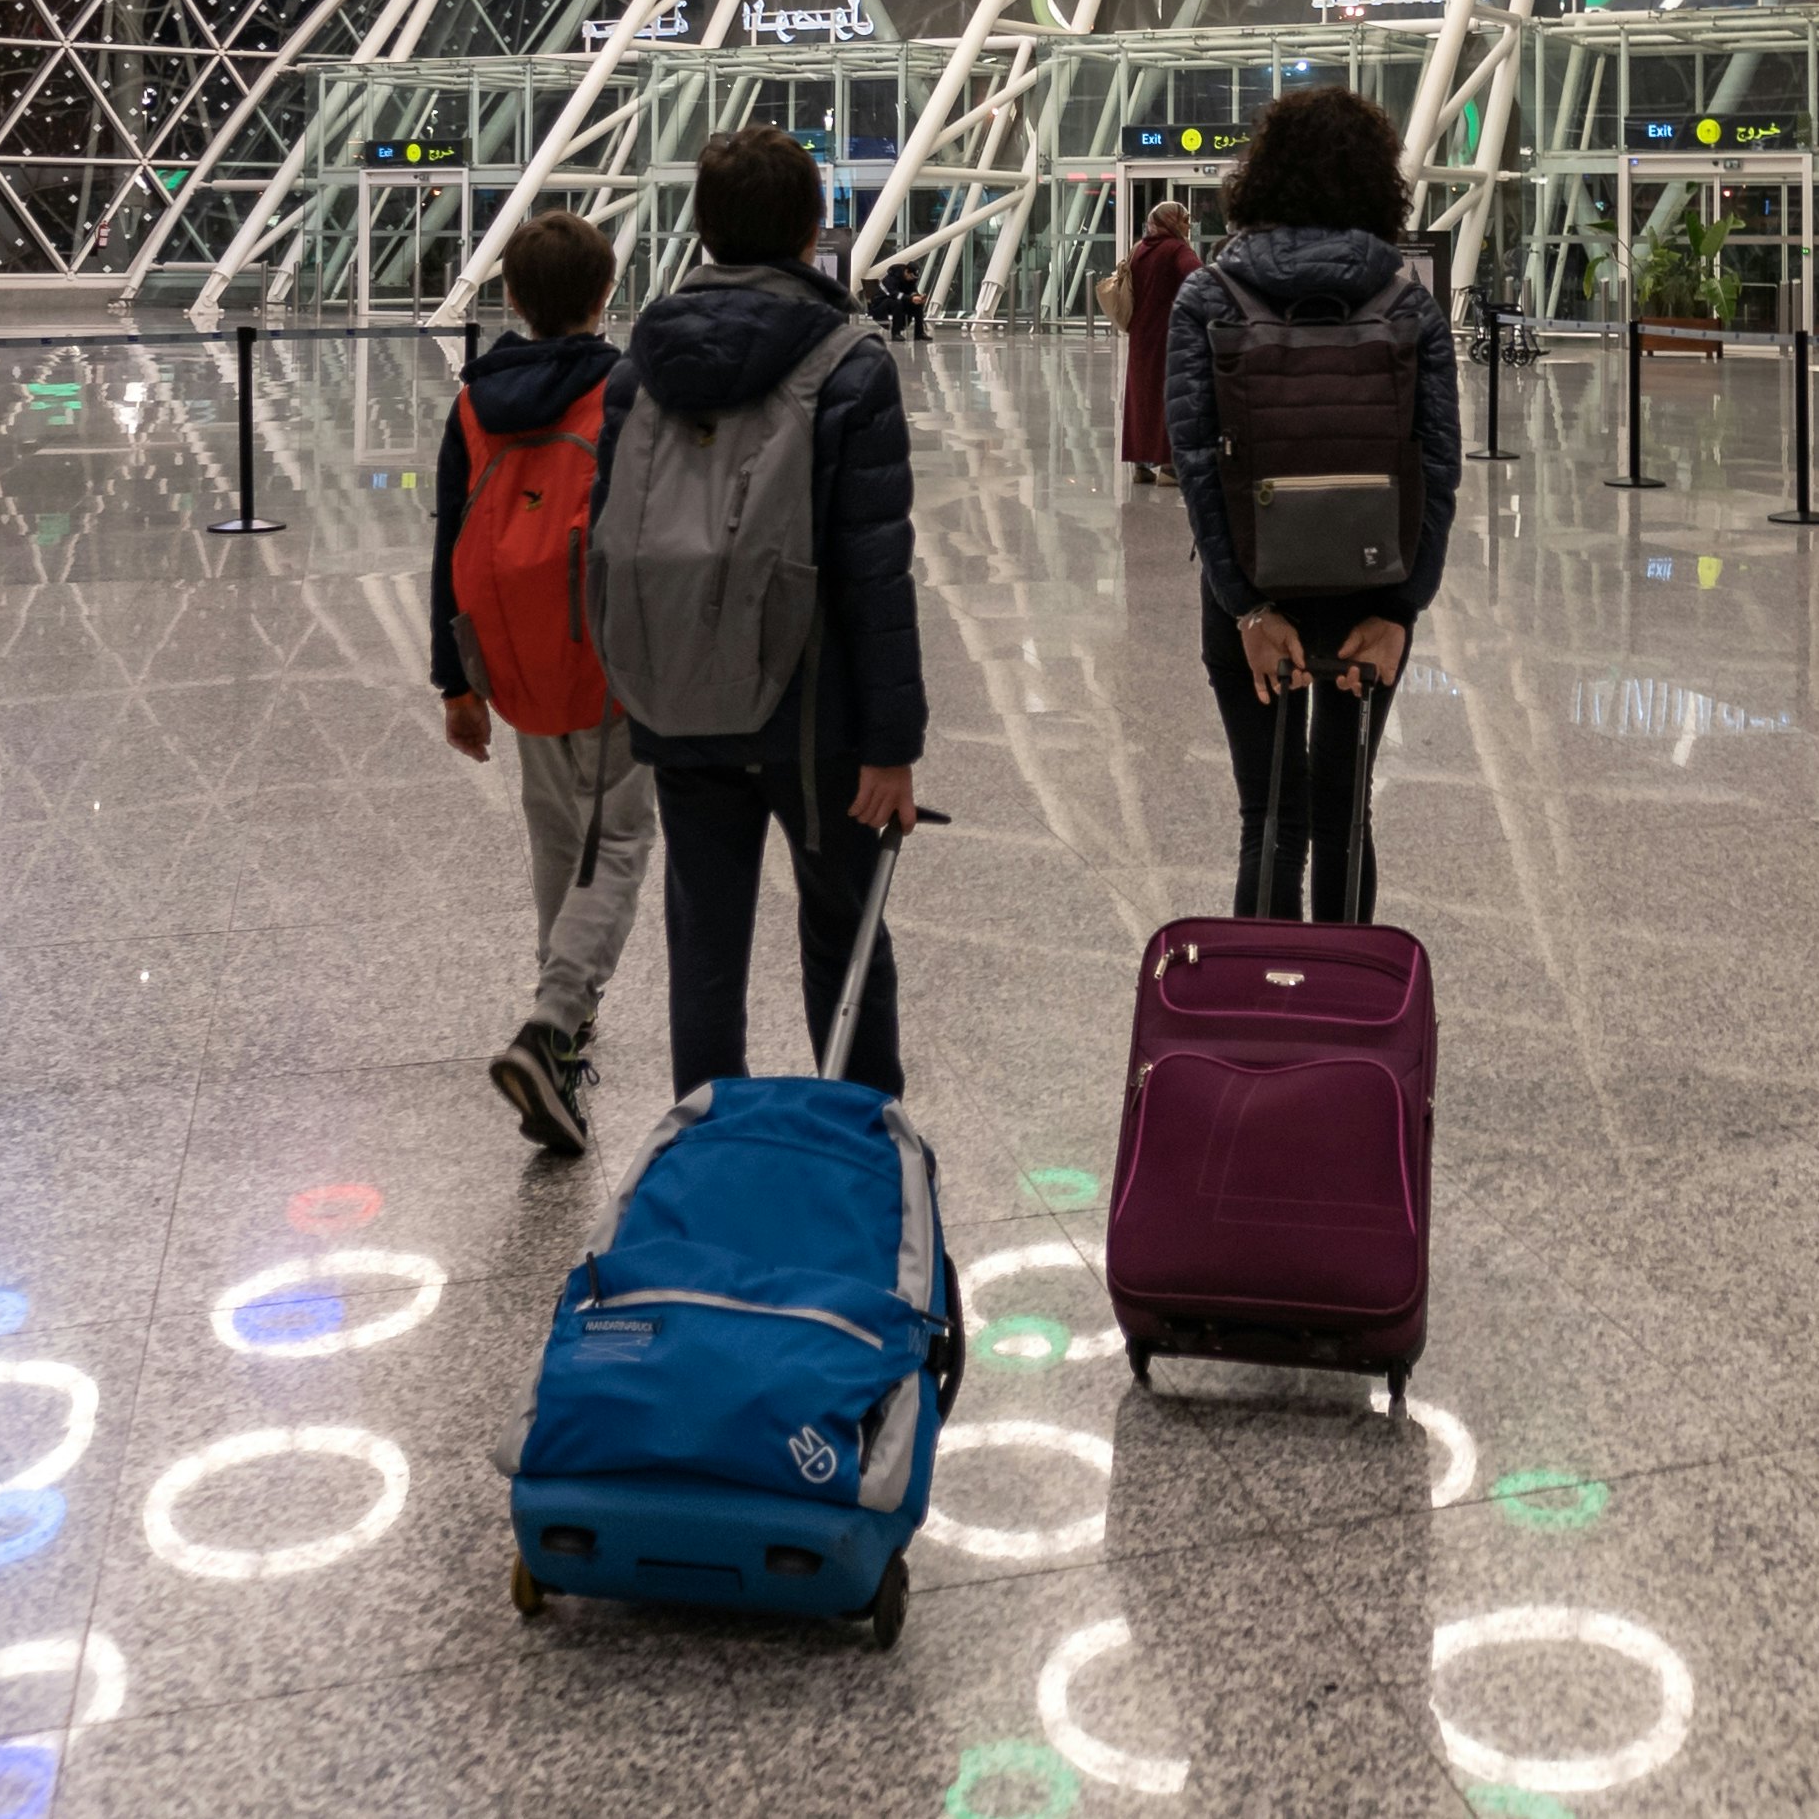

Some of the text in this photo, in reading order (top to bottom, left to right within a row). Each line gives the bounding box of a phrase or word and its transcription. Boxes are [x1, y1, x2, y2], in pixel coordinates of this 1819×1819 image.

[1647, 124, 1672, 138] Exit
[1735, 122, 1781, 142] خروج
[1141, 133, 1162, 146] Exit
[1213, 132, 1251, 149] خروج
[378, 147, 394, 158] Exit
[428, 146, 455, 161] خروج
